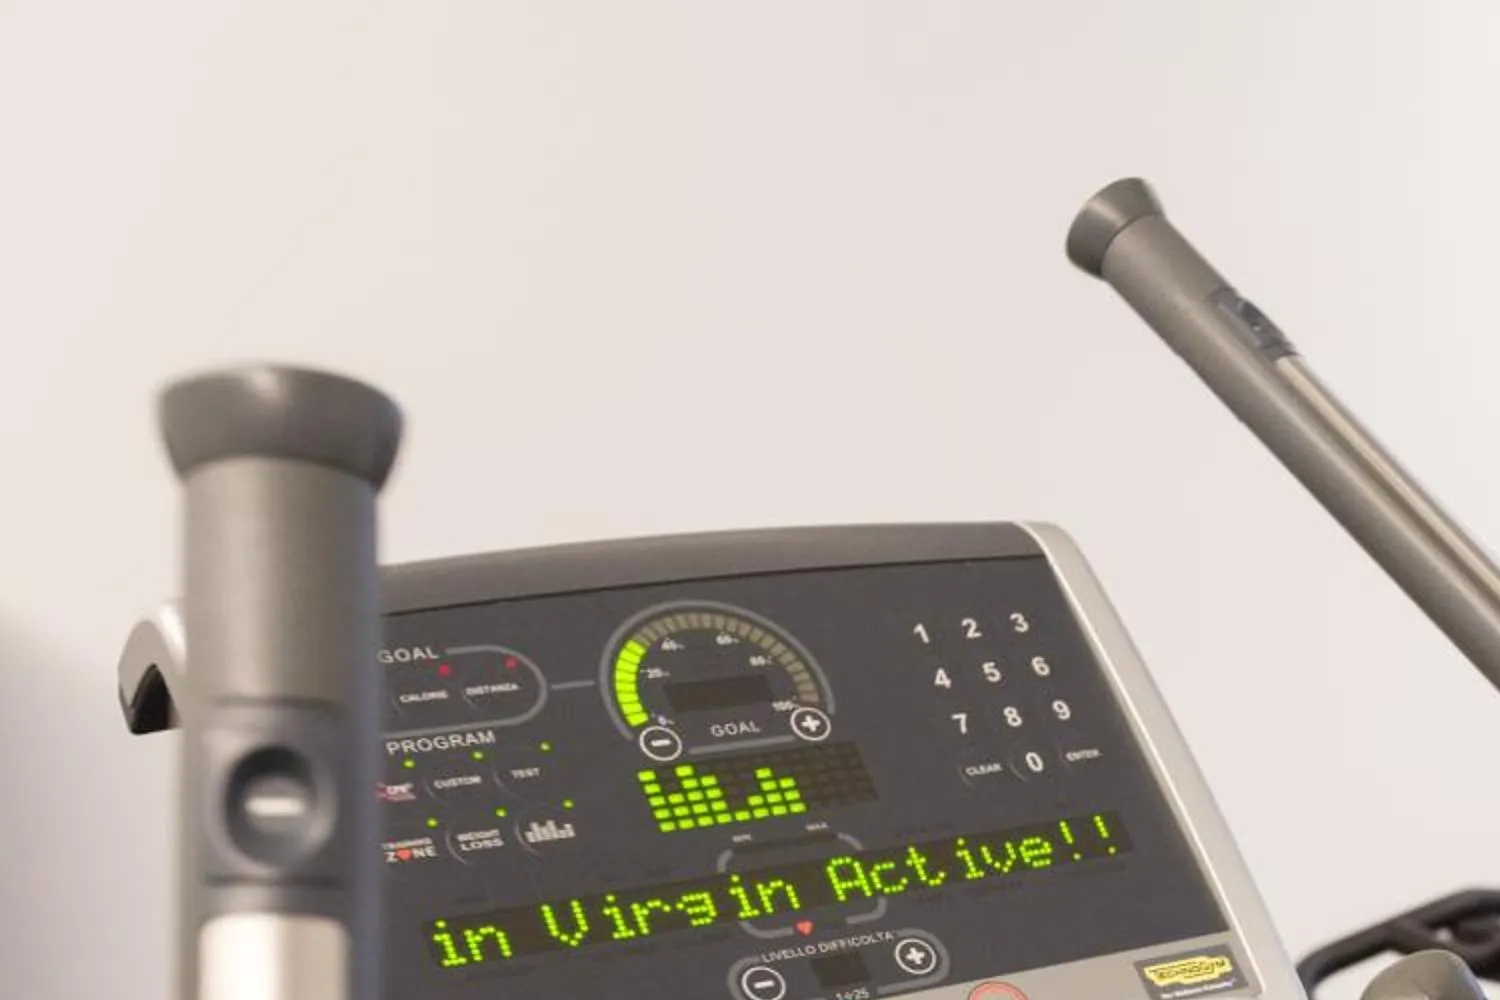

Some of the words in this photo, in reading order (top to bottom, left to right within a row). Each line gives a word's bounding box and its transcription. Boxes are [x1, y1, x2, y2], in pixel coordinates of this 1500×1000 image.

[912, 623, 931, 645] 1
[961, 618, 982, 639] 2
[1009, 612, 1030, 633] 3
[377, 646, 440, 664] GOAL
[933, 668, 952, 689] 4
[982, 661, 1002, 683] 5
[1031, 656, 1051, 677] 6
[710, 720, 761, 737] GOAL
[950, 712, 970, 734] 7
[1002, 706, 1023, 727] 8
[1051, 700, 1072, 720] 9
[385, 730, 497, 756] PROGRAM
[510, 767, 542, 779] TEST
[1025, 751, 1045, 773] 0
[432, 919, 513, 968] in
[540, 874, 800, 948] Virgin
[824, 815, 1118, 901] Active!!
[760, 944, 817, 963] LIVELLO
